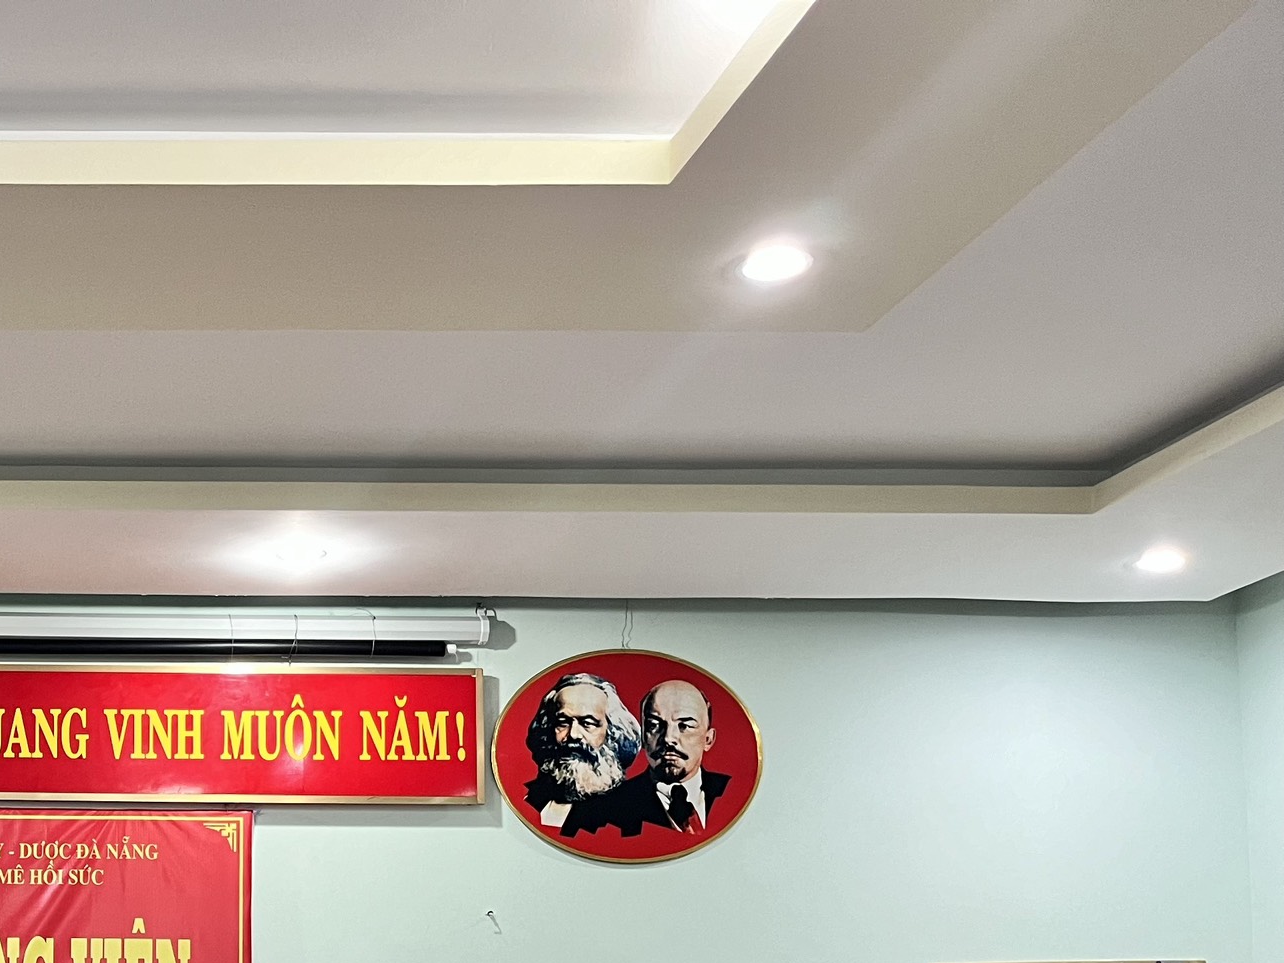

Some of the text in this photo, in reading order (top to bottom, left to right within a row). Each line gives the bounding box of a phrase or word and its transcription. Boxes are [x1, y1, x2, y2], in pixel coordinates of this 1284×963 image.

[104, 708, 205, 760] VINH
[220, 693, 343, 762] MUÔN
[359, 694, 468, 762] NĂM!
[19, 840, 72, 863] DƯỢC
[76, 838, 102, 860] ĐÀ
[106, 836, 159, 861] NẴNG
[29, 861, 65, 886] HỒI
[68, 864, 105, 886] SỨC
